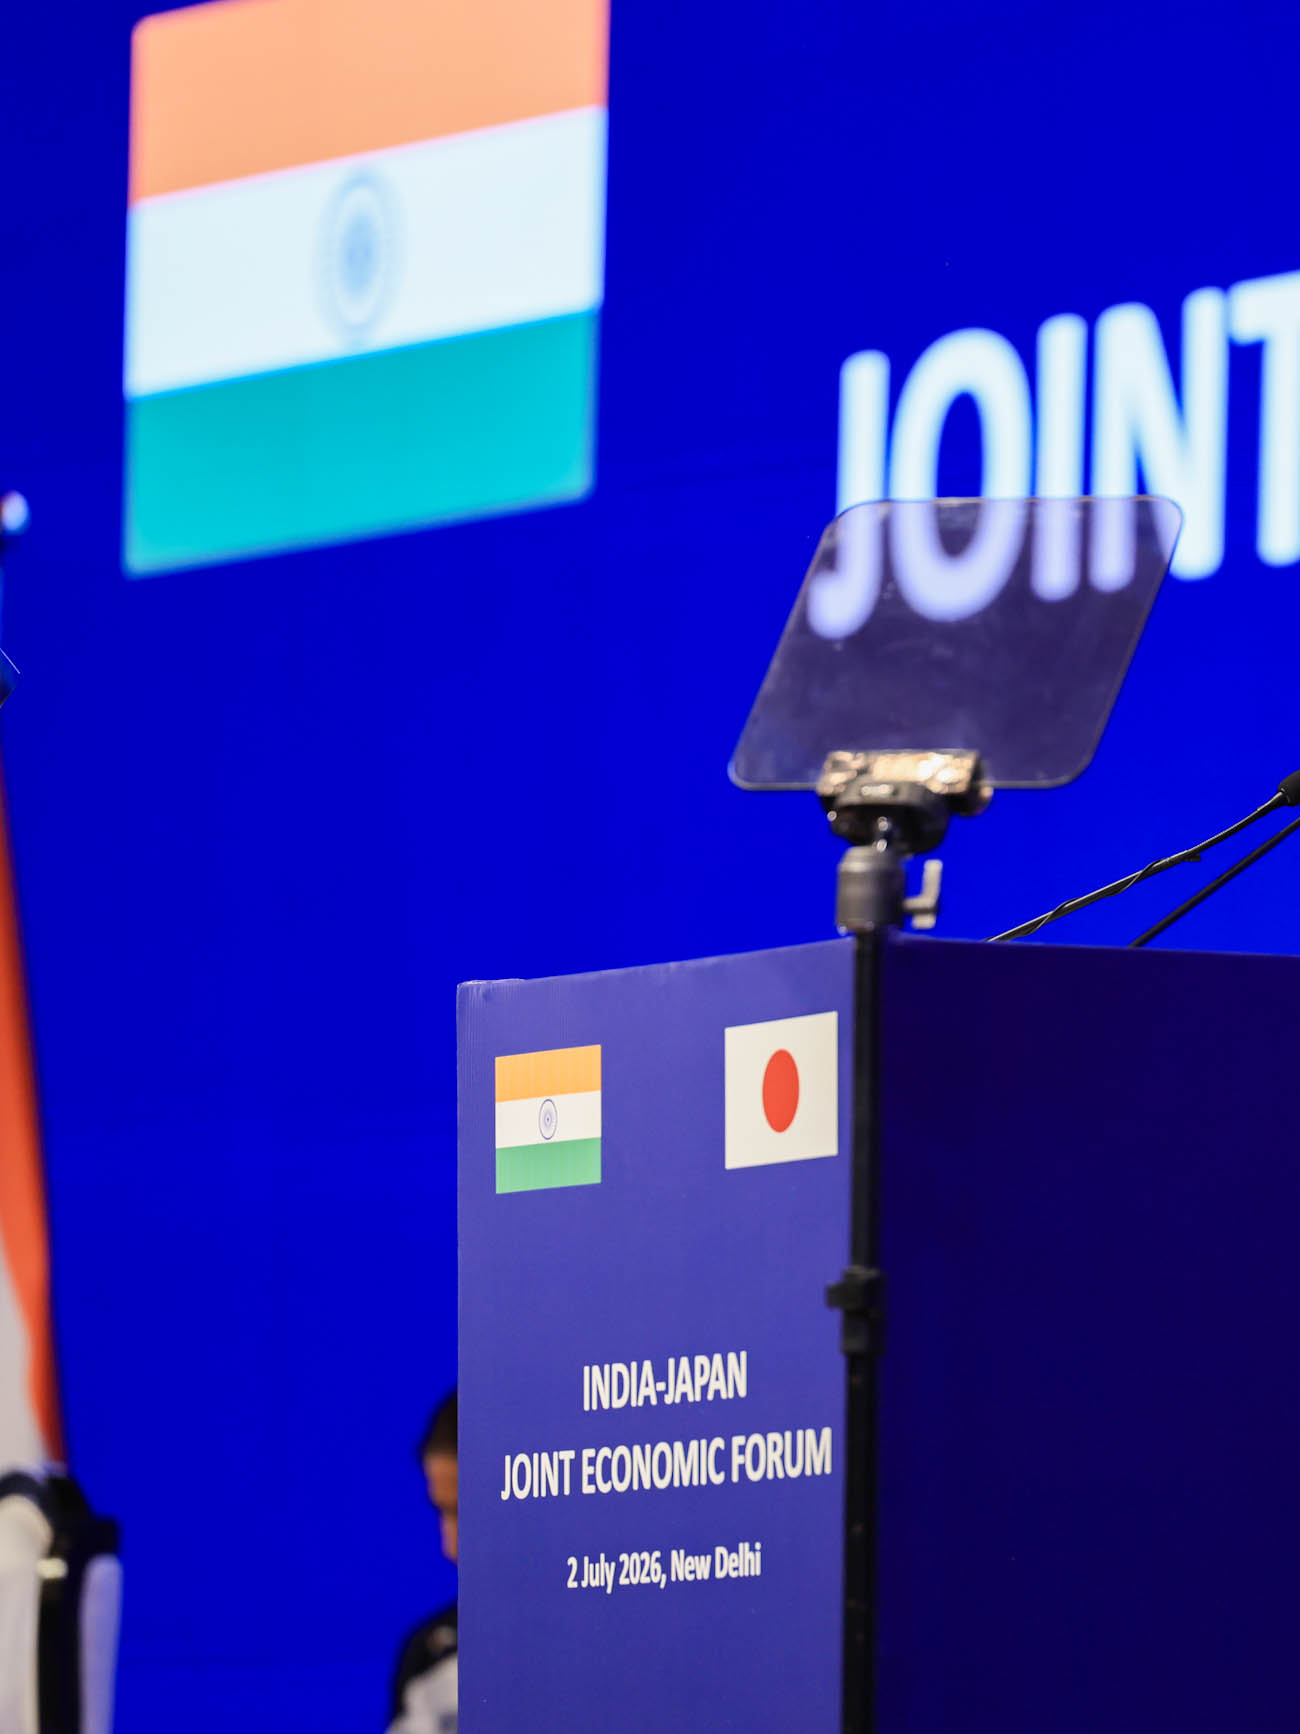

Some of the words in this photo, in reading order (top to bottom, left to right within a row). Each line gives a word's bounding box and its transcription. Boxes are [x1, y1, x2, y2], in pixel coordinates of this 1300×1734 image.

[583, 1350, 748, 1412] INDIA-JAPAN
[501, 1449, 576, 1501] JOINT
[582, 1436, 726, 1495] ECONOMIC
[731, 1426, 833, 1484] FORUM
[566, 1556, 578, 1589] 2
[581, 1552, 616, 1595] July
[618, 1550, 667, 1589] 2026,
[670, 1548, 712, 1583] New
[714, 1541, 762, 1580] Delhi
